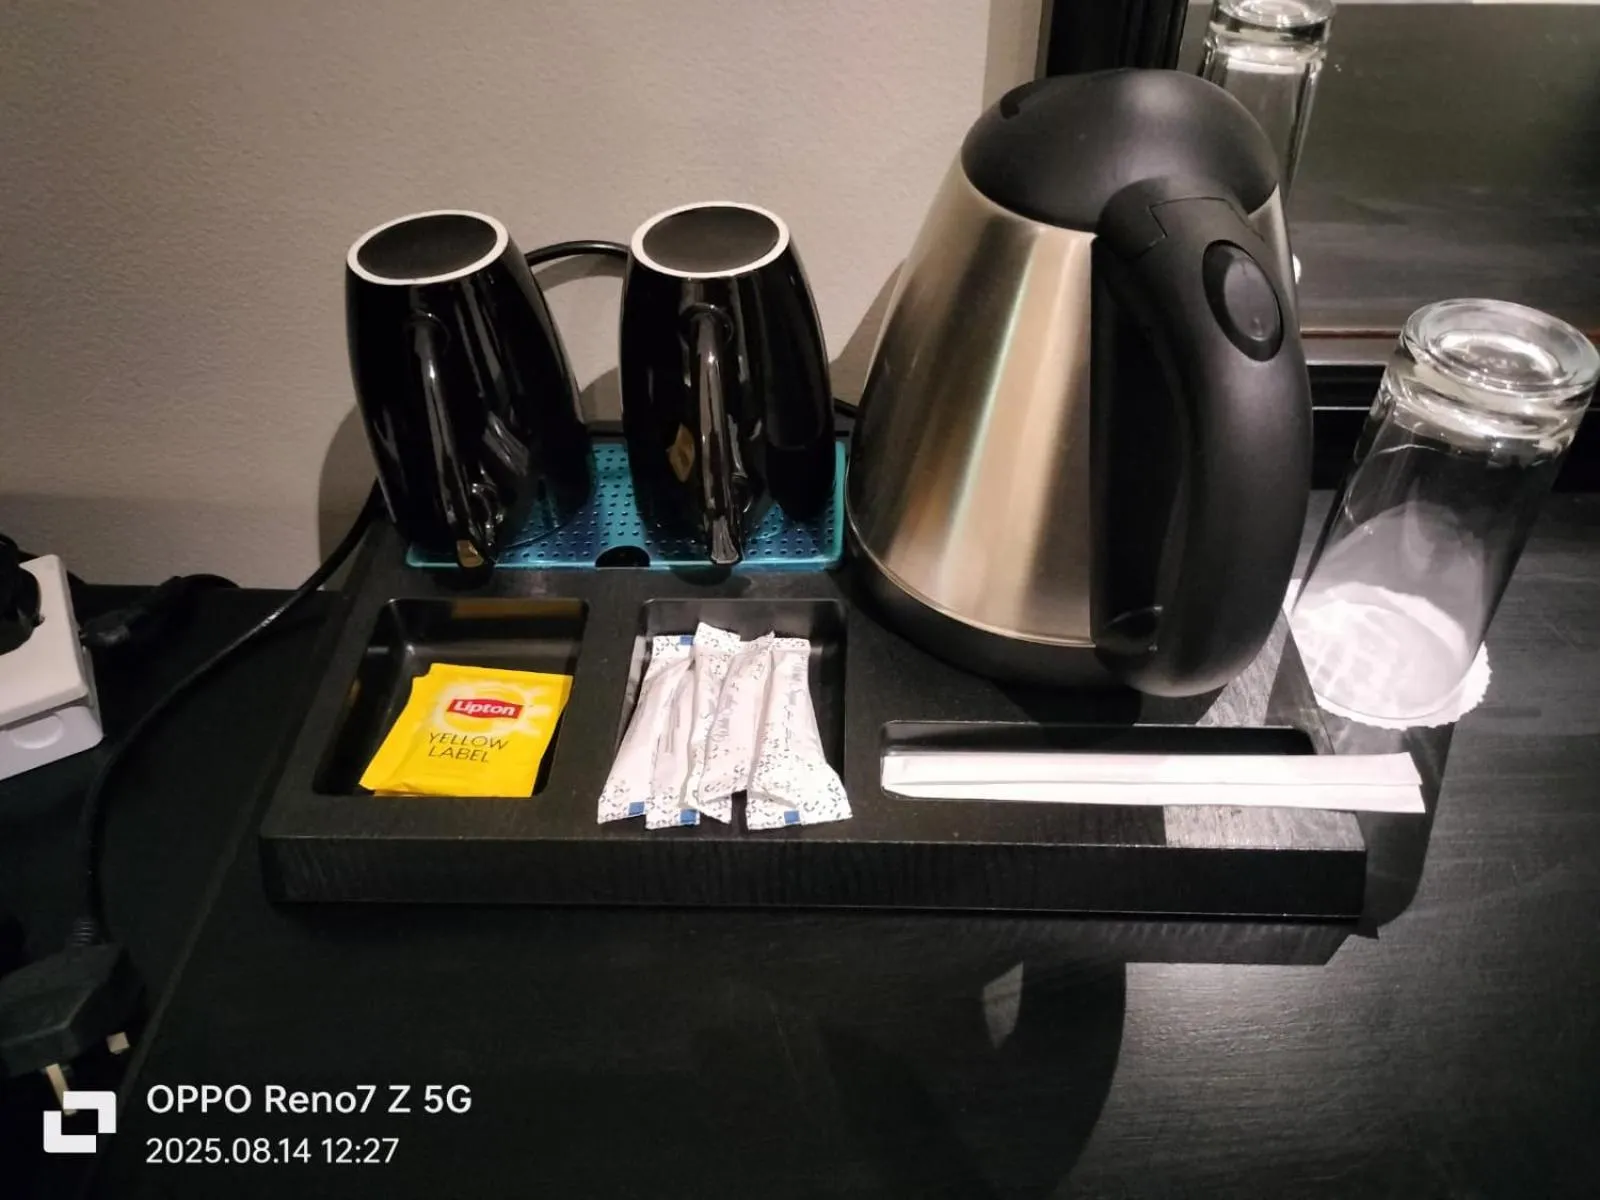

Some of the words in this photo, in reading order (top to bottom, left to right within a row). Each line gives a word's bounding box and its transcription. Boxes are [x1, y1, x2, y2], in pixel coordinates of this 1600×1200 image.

[453, 700, 516, 717] Lipton
[430, 732, 508, 750] YELLOW
[428, 746, 489, 764] LABEL
